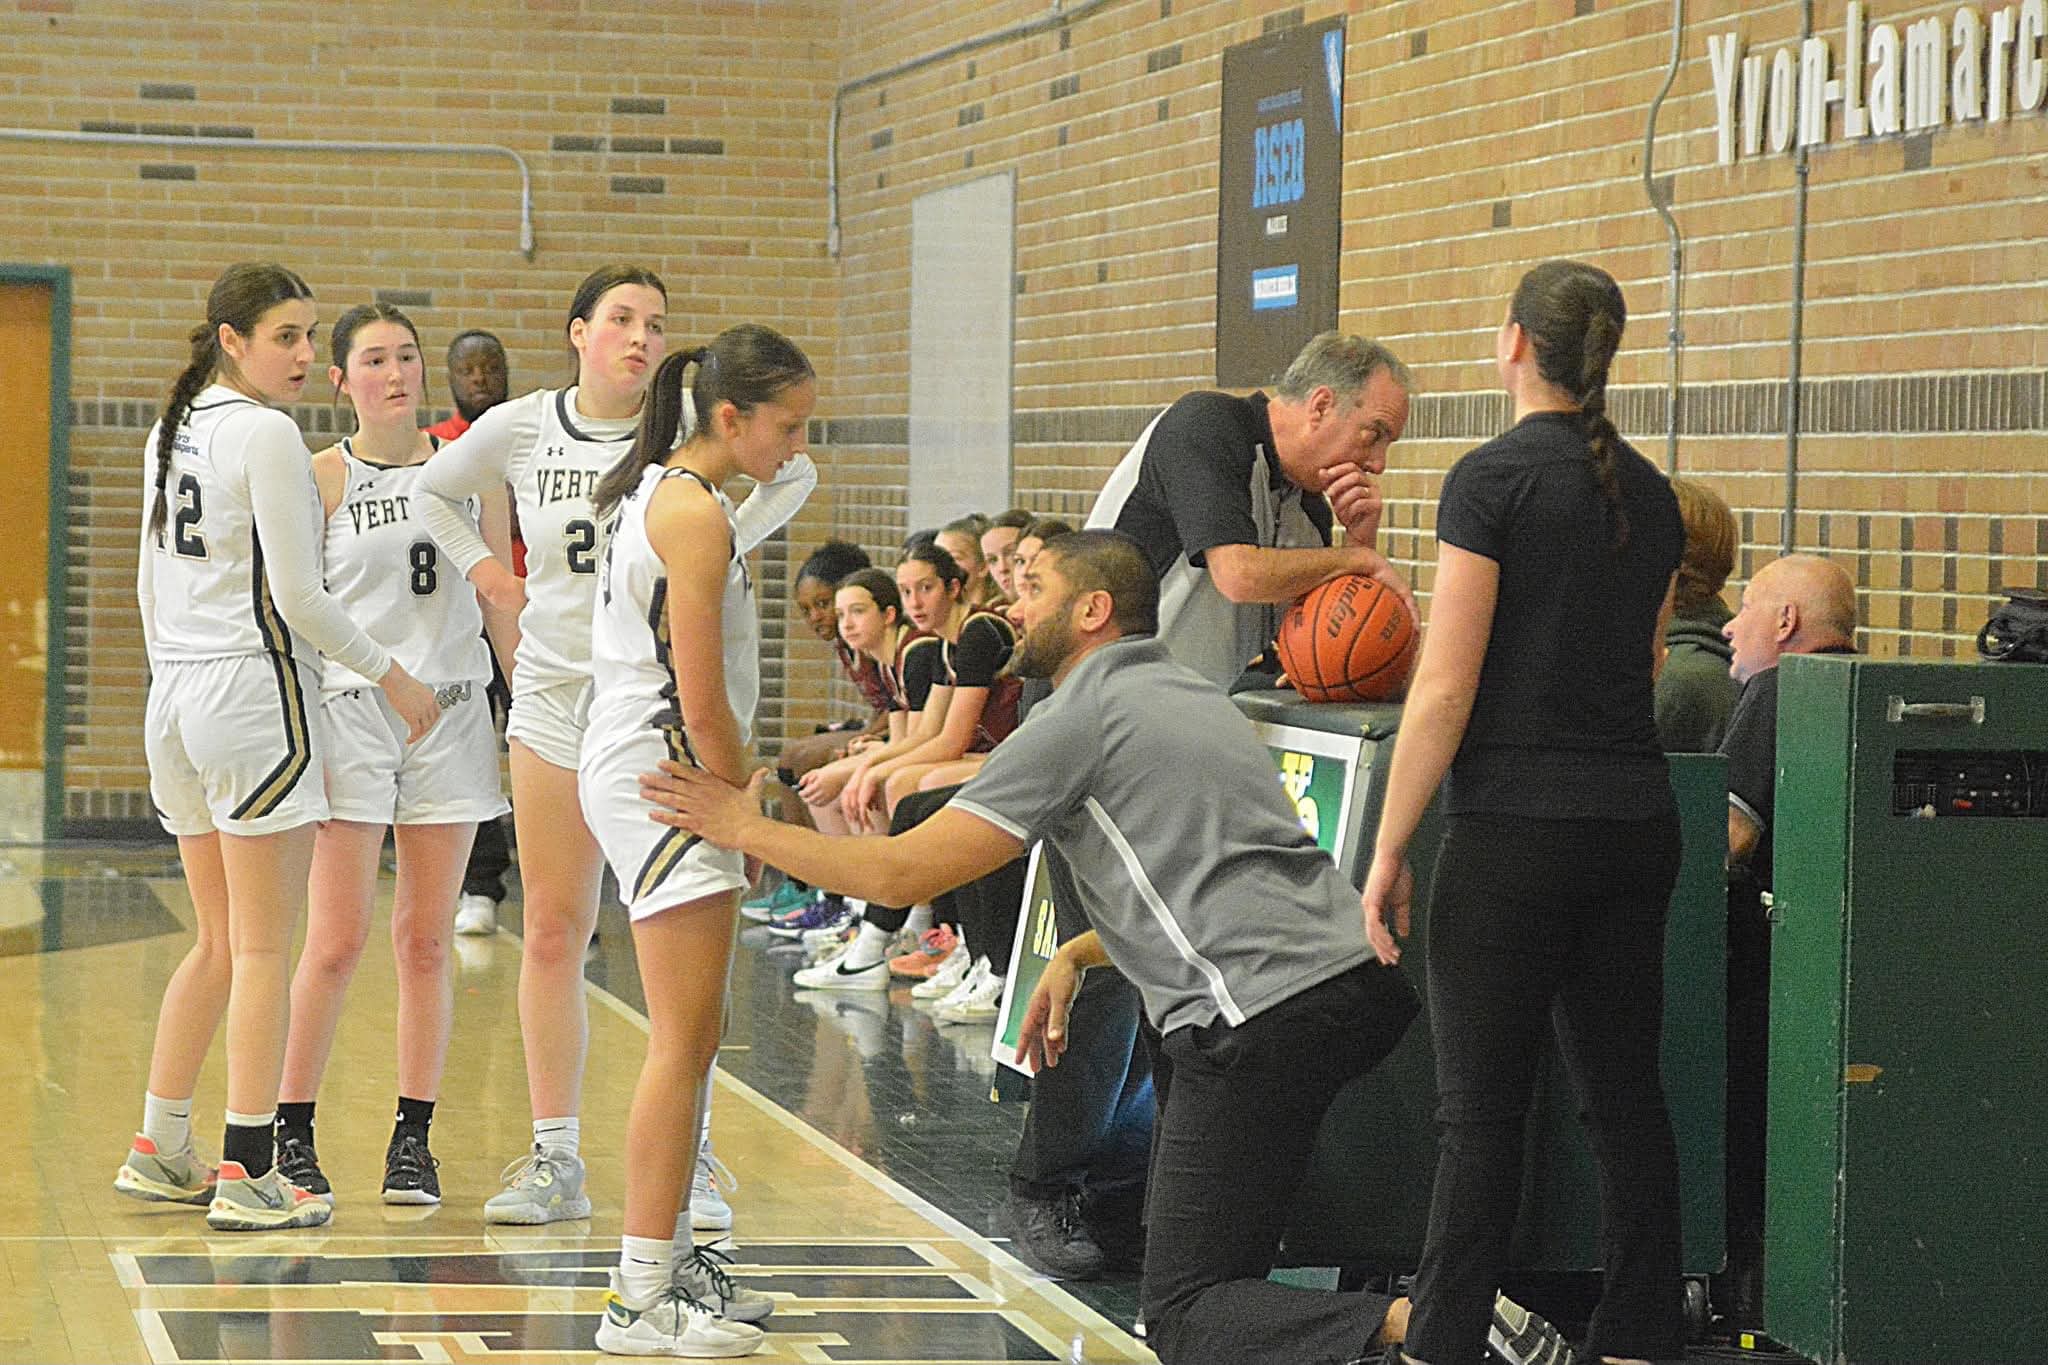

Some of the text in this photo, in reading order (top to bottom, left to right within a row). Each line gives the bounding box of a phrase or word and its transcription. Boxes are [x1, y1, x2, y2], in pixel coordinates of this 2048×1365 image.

[158, 472, 208, 559] 2
[348, 496, 409, 535] VERT
[537, 469, 598, 508] VERT
[408, 541, 438, 596] 8
[564, 518, 614, 575] 2
